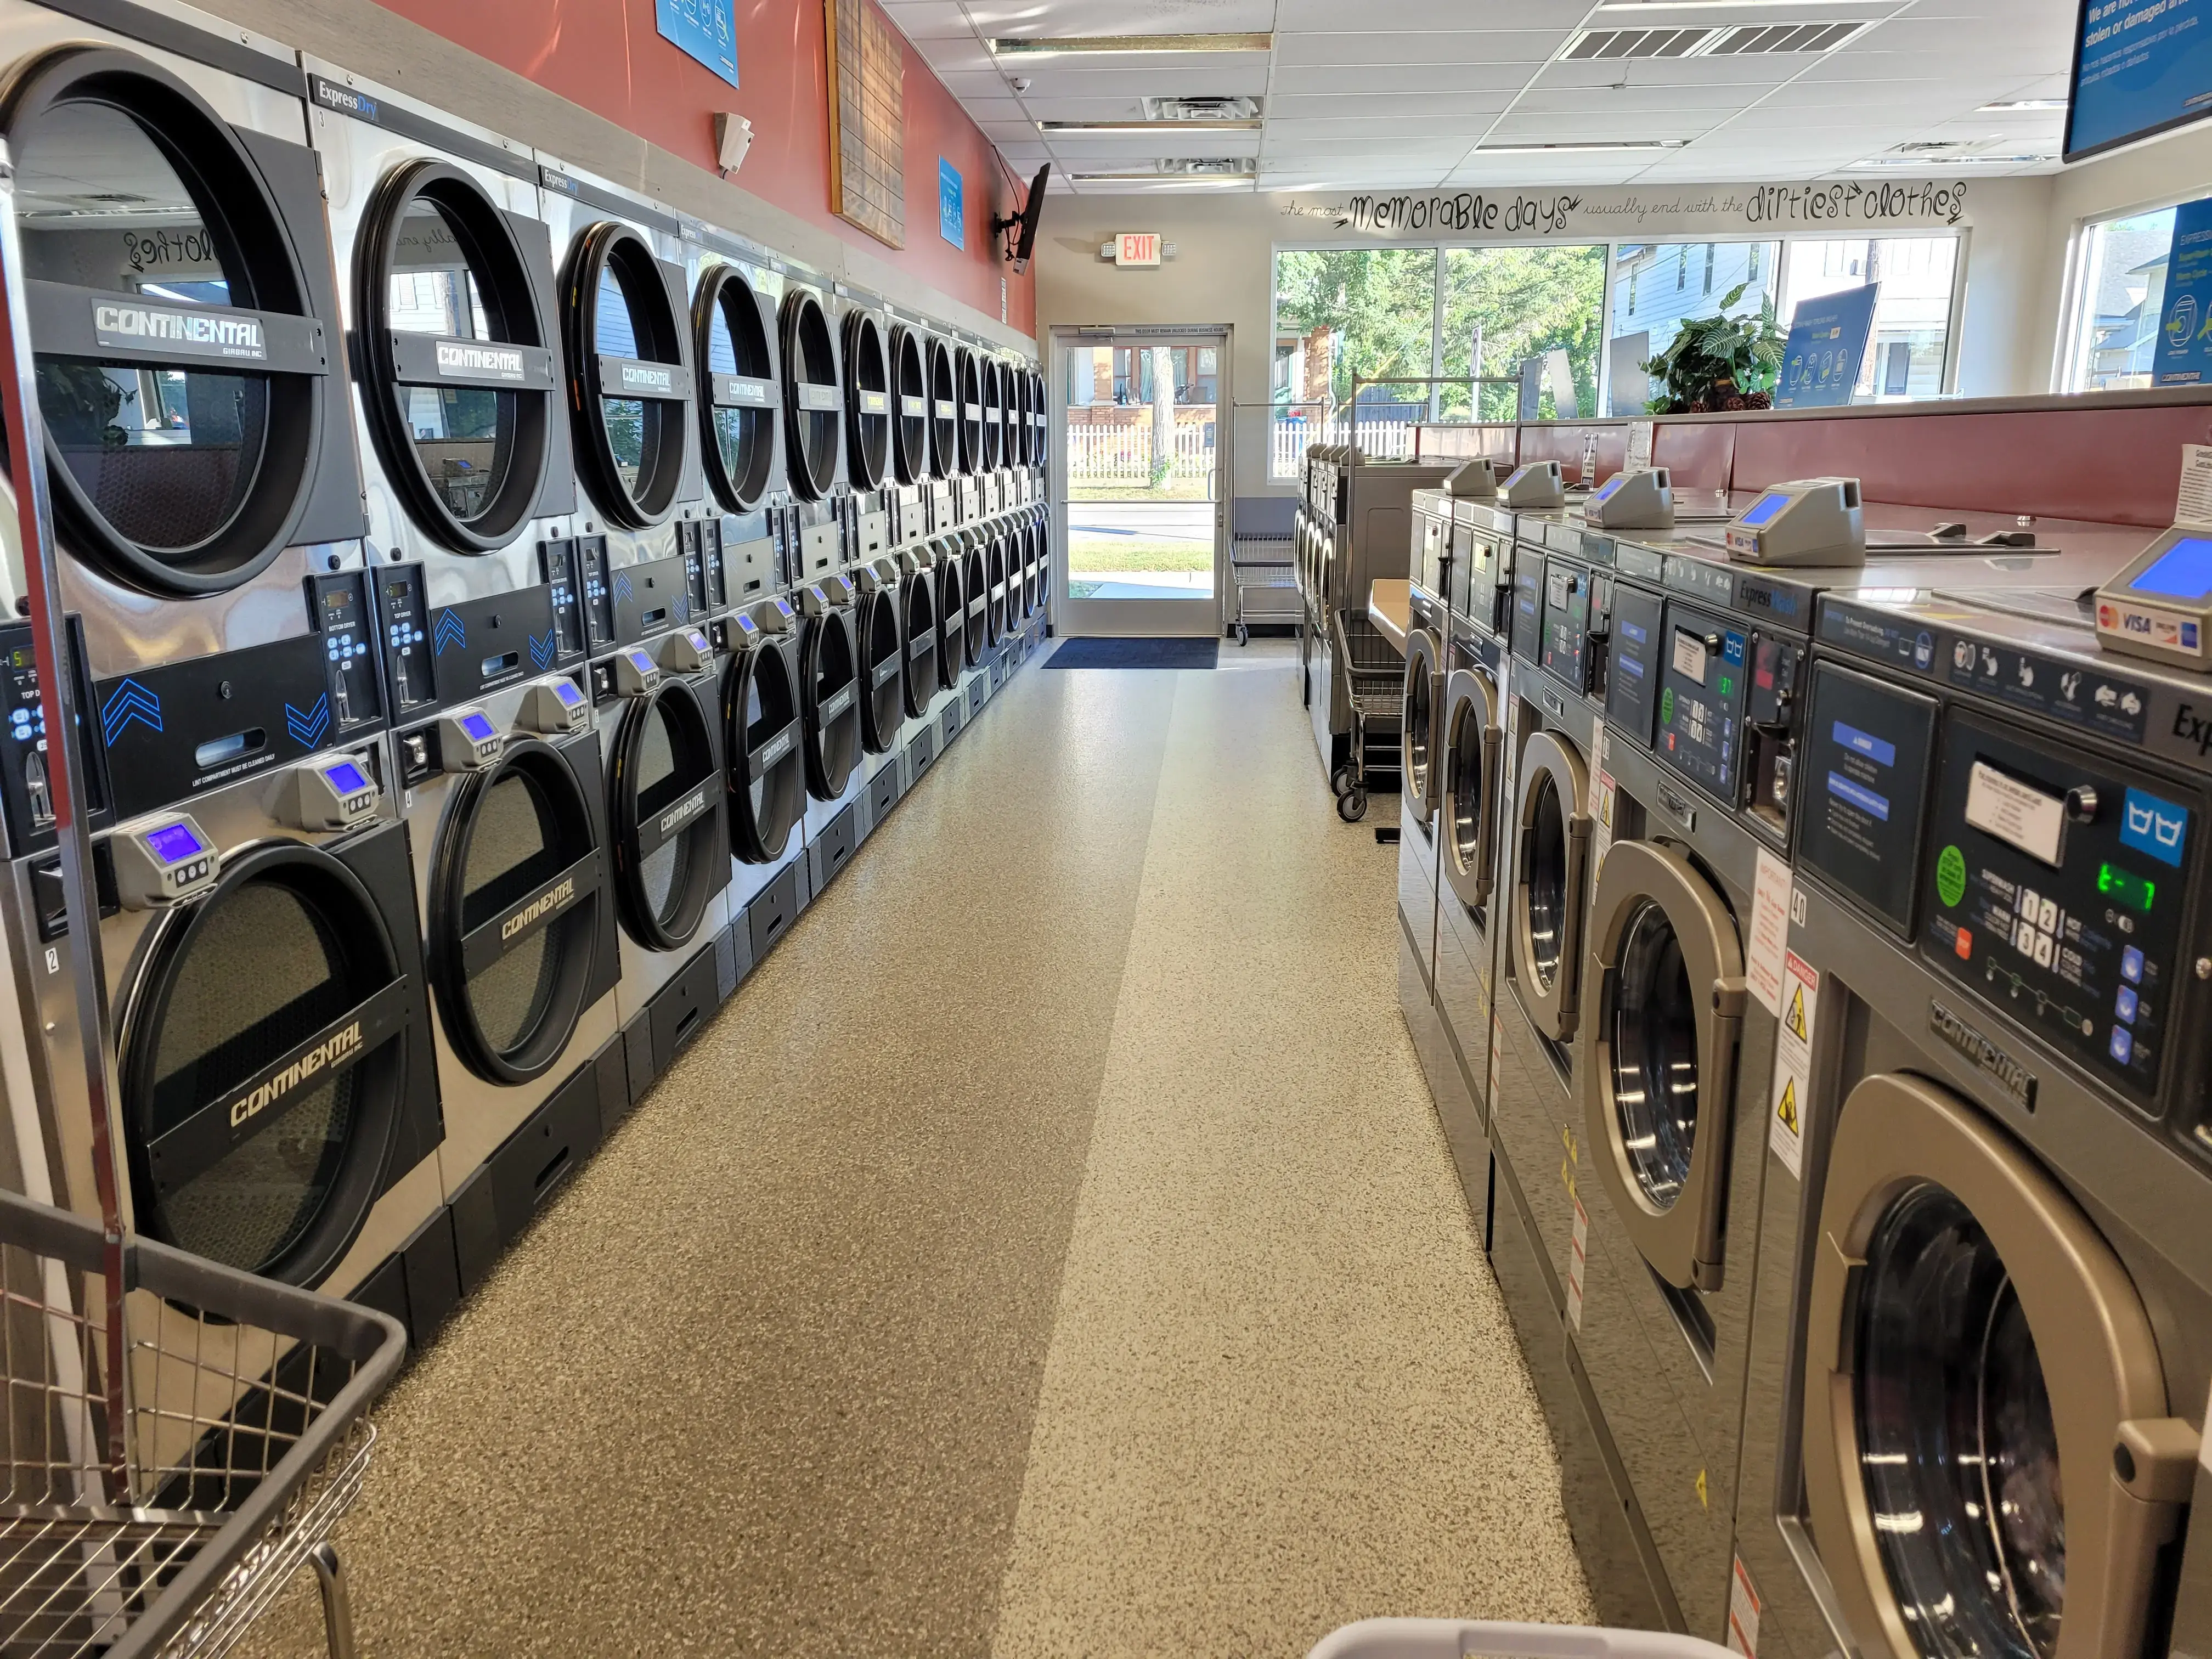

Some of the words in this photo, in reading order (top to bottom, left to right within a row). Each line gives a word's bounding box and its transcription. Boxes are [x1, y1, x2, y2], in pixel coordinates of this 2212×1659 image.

[2085, 27, 2111, 47] stolen
[2112, 20, 2123, 35] or
[2124, 1, 2166, 30] damaged
[2089, 7, 2101, 24] We
[2103, 2, 2117, 18] are
[319, 81, 377, 120] ExpressDry
[319, 111, 324, 127] 3
[1307, 204, 1344, 217] most
[1505, 194, 1583, 234] days
[1584, 197, 1647, 222] usually
[1651, 198, 1681, 213] end
[1684, 196, 1718, 213] with
[1721, 195, 1743, 213] the
[1746, 185, 1854, 222] dirtiest
[1865, 181, 1967, 225] clothes
[1124, 235, 1154, 260] EXIT
[97, 307, 261, 347] CONTINENTAL
[439, 347, 522, 371] CONTINENTAL
[623, 368, 670, 386] CONTINENTAL
[329, 623, 343, 631] BOTTOM
[2123, 612, 2151, 635] VISA
[21, 690, 34, 699] TOP
[192, 778, 201, 787] LINT
[202, 768, 230, 783] COMPARTMENT
[231, 765, 242, 773] MUST
[242, 762, 248, 770] BE
[248, 757, 264, 768] CLEANED
[265, 753, 275, 761] DAILY
[661, 791, 704, 832] CONTINENTAL
[502, 877, 574, 940] CONTINENTAL
[1793, 891, 1805, 926] 40
[2029, 900, 2033, 915] 1
[2045, 909, 2051, 927] 2
[49, 950, 57, 970] 2
[2024, 933, 2029, 950] 3
[2040, 944, 2046, 961] 4
[1793, 961, 1816, 988] DANGER
[230, 1021, 363, 1127] CONTINENTAL
